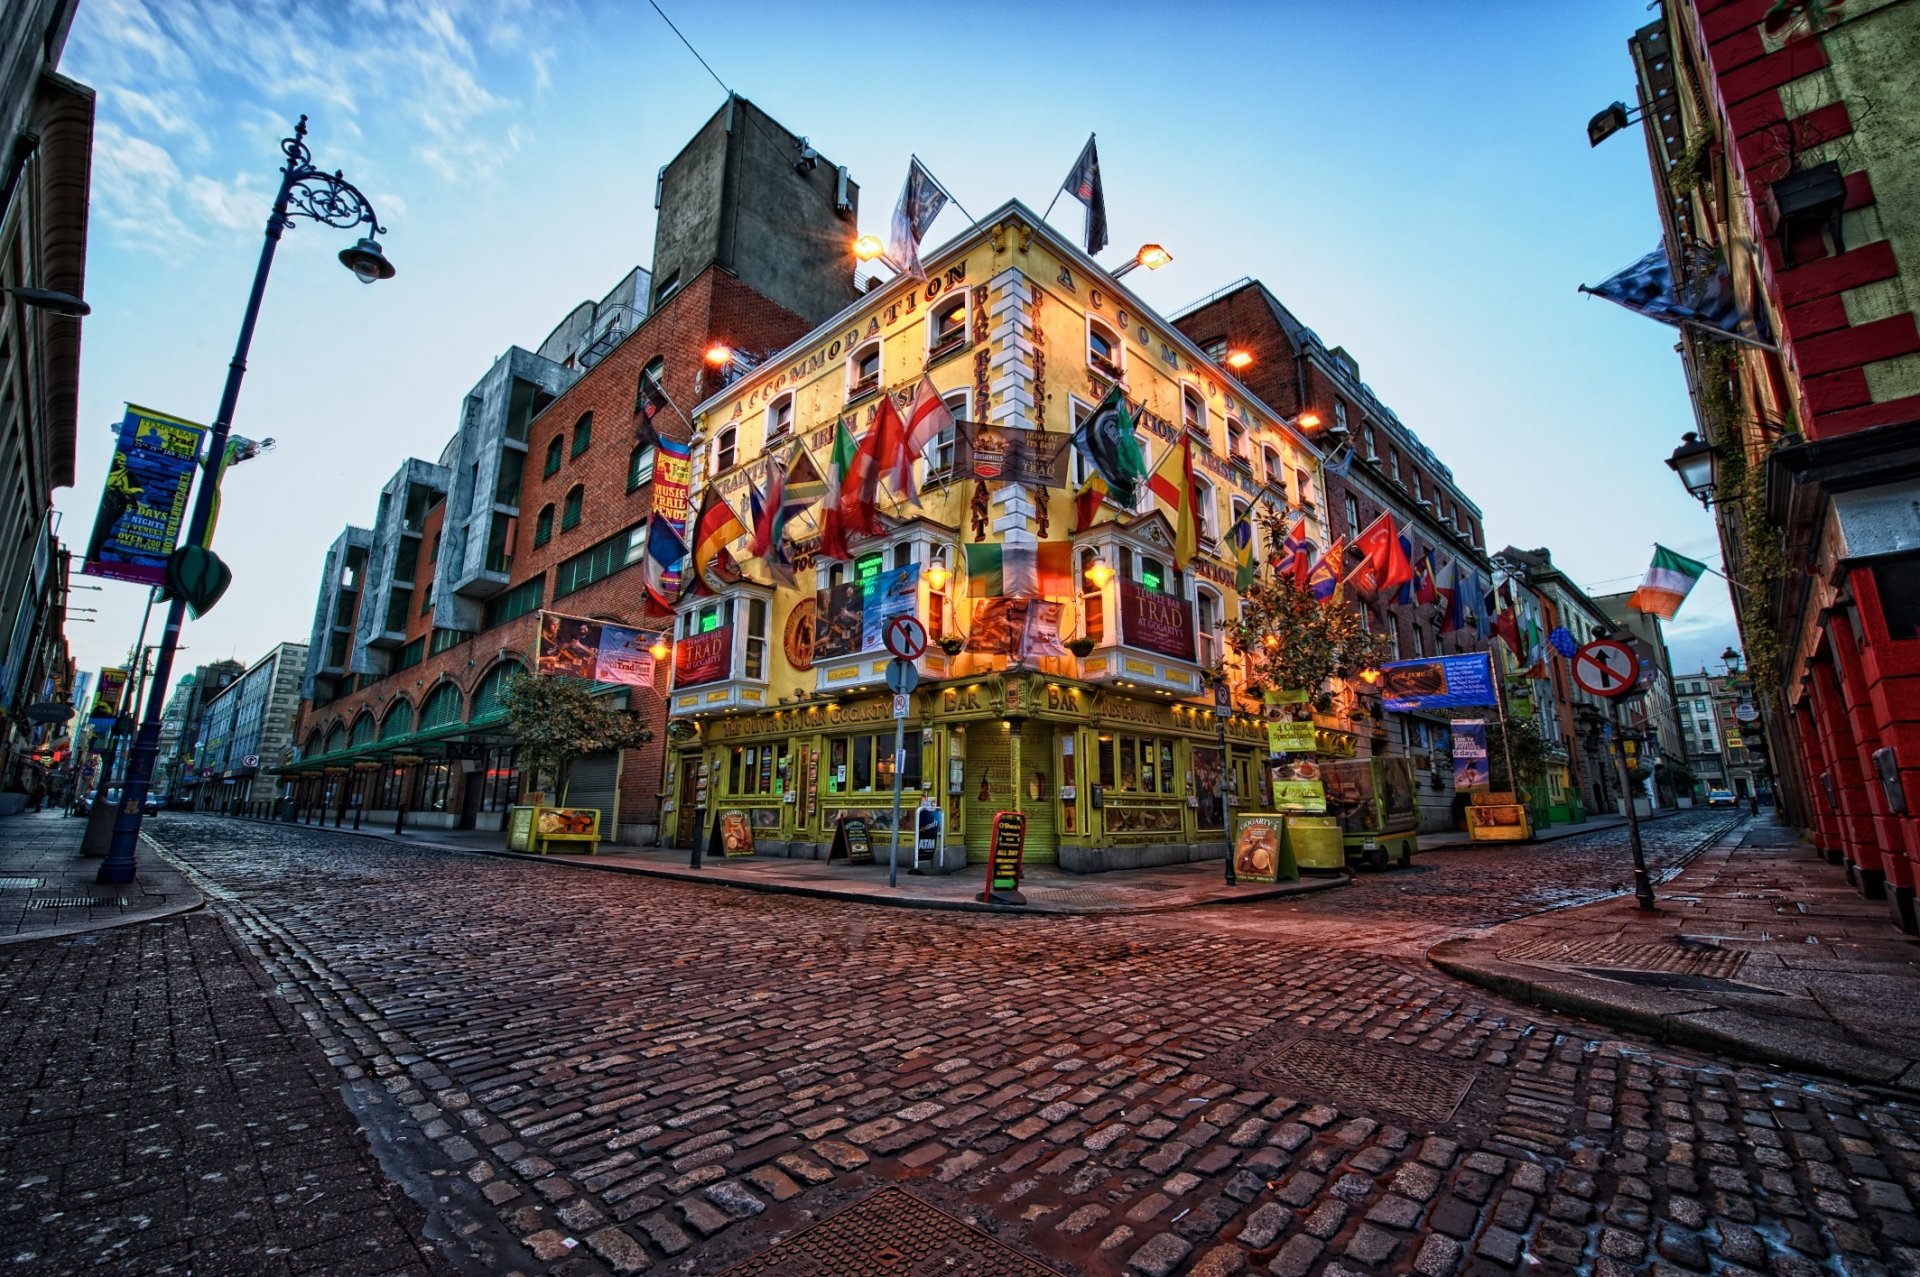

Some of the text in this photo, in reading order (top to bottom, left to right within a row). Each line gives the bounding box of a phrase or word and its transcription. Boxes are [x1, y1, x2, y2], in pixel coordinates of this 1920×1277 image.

[1031, 284, 1045, 346] BAR
[731, 259, 968, 420] ACCOMMODATION
[973, 285, 991, 542] BAR RESTANT
[167, 433, 195, 447] Trad
[811, 413, 858, 452] IRIH
[1032, 346, 1050, 539] RESTANT
[1022, 463, 1055, 475] TRAD
[653, 493, 686, 510] TRAIL
[654, 483, 687, 499] MUSIC
[126, 503, 169, 521] 5 DAYS
[131, 515, 166, 530] NIGHTS
[117, 532, 143, 545] OVER
[1136, 596, 1183, 628] TRAD
[1138, 617, 1147, 627] AT
[686, 638, 722, 662] TRAD
[944, 689, 981, 713] BAR
[1048, 687, 1079, 712] BAR
[724, 719, 740, 737] THE
[743, 716, 780, 735] OLIVER
[831, 702, 893, 725] GOGARTY
[1102, 701, 1162, 725] RESTAURANT
[1277, 723, 1283, 732] 4
[918, 838, 936, 850] ATM
